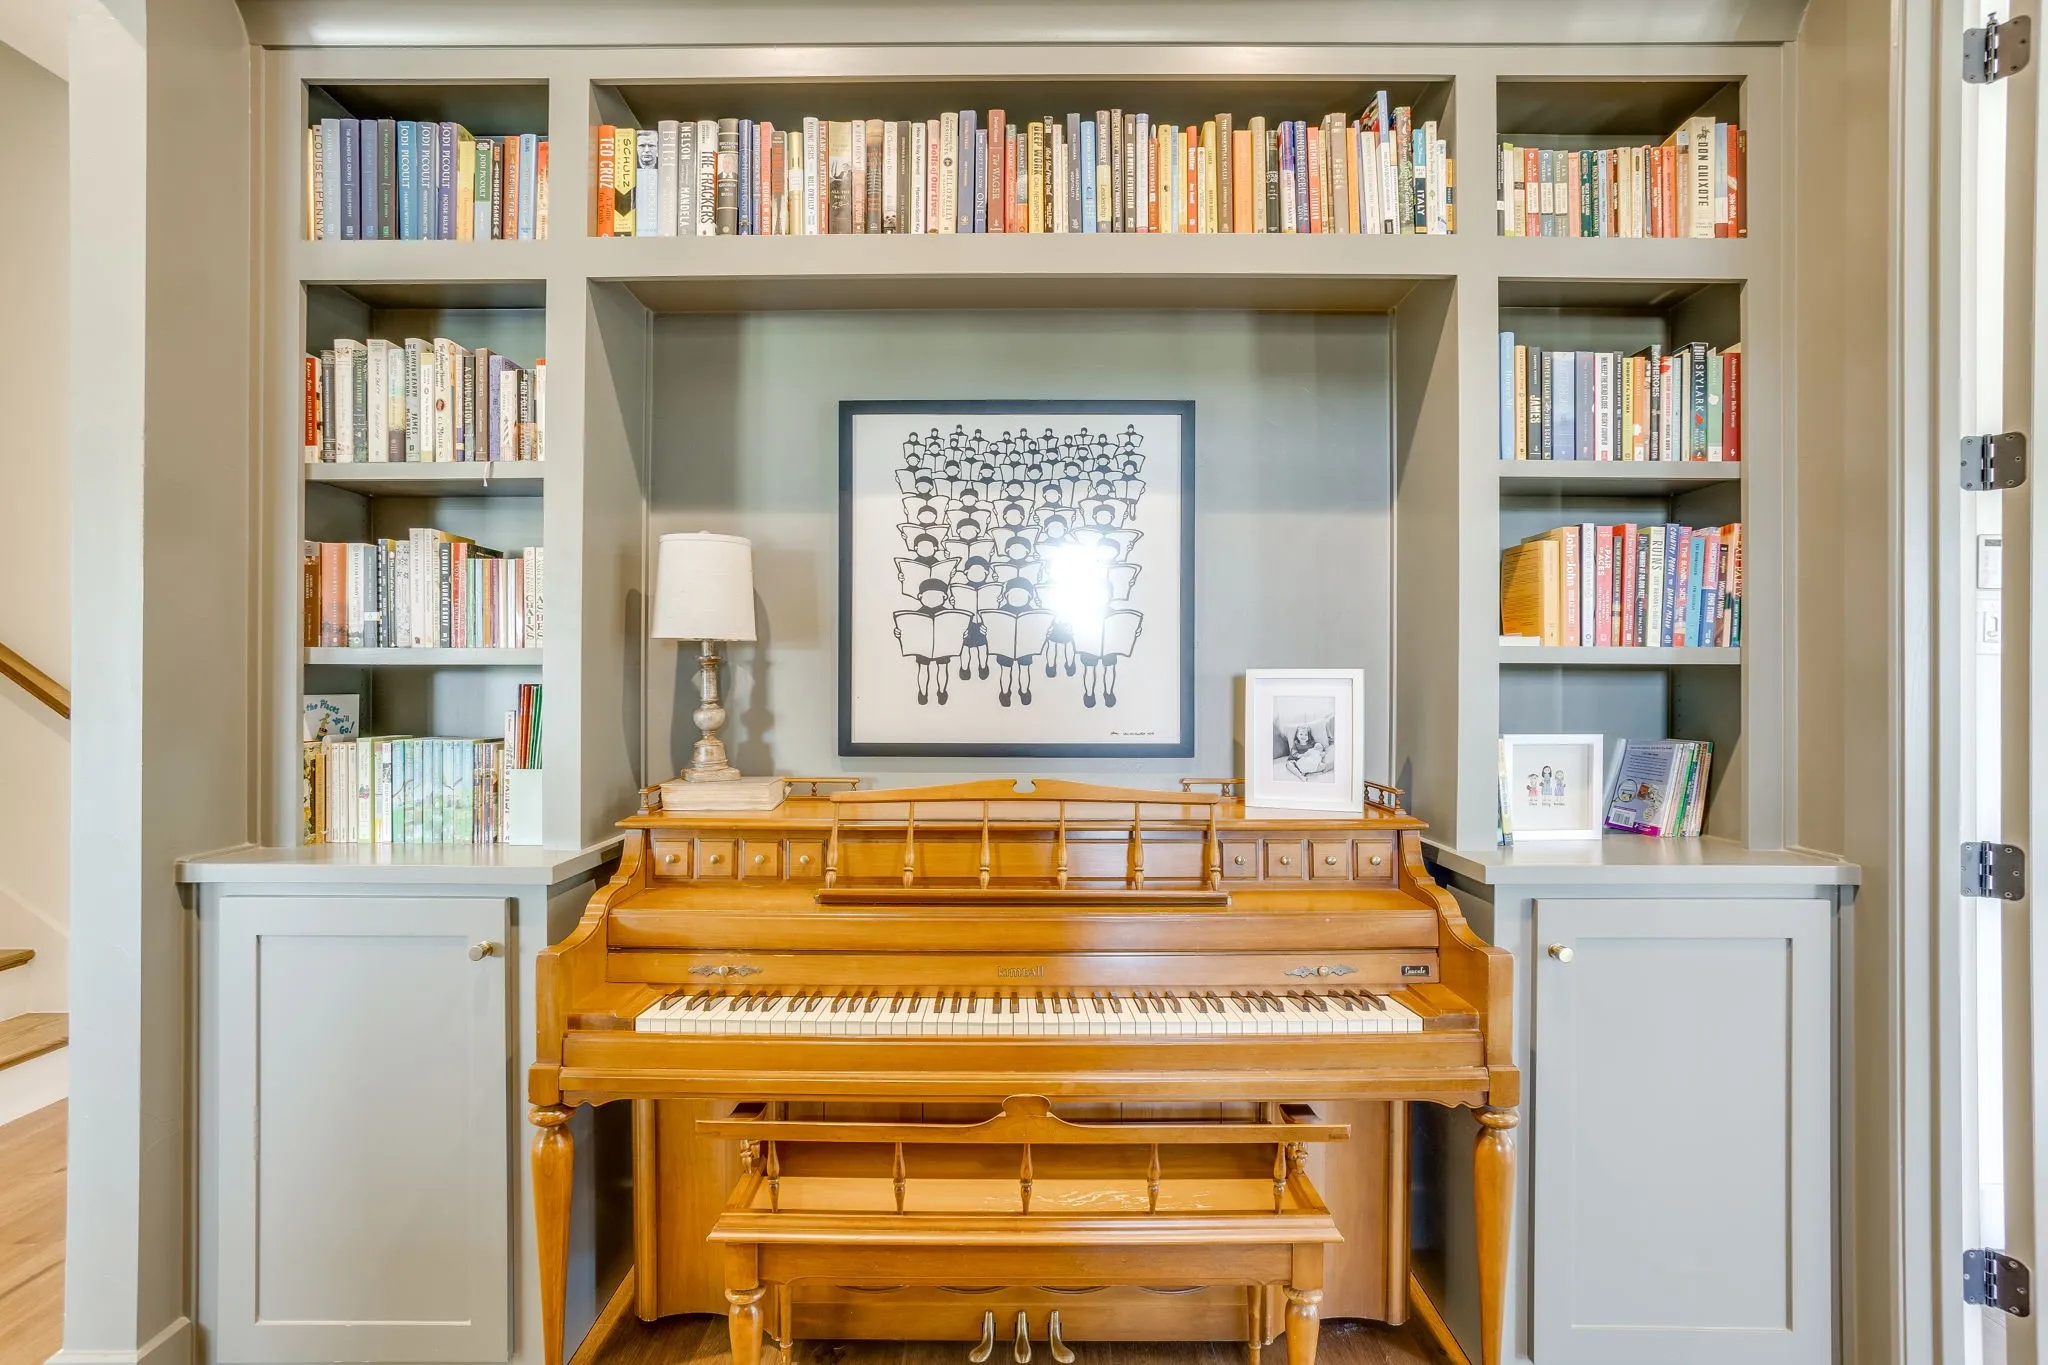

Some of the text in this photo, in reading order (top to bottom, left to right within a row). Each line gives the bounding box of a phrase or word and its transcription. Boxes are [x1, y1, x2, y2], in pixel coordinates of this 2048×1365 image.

[400, 125, 409, 188] JODI PICOULT
[421, 125, 431, 188] JODI PICOULT
[442, 125, 452, 188] JODI PICOULT
[662, 130, 676, 167] BIBI
[681, 126, 691, 160] NELSON
[855, 145, 863, 164] DENT
[1033, 126, 1042, 175] DEEP WORK
[1296, 125, 1306, 195] PLUNDER DECEIT
[600, 137, 614, 189] TED CRUZ
[1697, 142, 1709, 206] DON QUIXOTE
[701, 151, 715, 224] THE FRACKERS
[1100, 184, 1108, 218] Leadership
[1417, 190, 1425, 215] ITALY
[680, 187, 689, 227] MANDELA
[1652, 364, 1660, 397] HEROES
[1695, 364, 1704, 412] SKYLARK
[520, 381, 528, 421] KEN FOLLETT
[1530, 395, 1541, 423] JAMES
[1601, 413, 1609, 446] BECKY COOPER
[1652, 540, 1663, 570] RUINS
[1679, 560, 1688, 586] BURNING
[525, 595, 534, 640] CHAINS
[306, 703, 318, 711] the
[320, 699, 340, 714] Places
[339, 721, 355, 734] Go!
